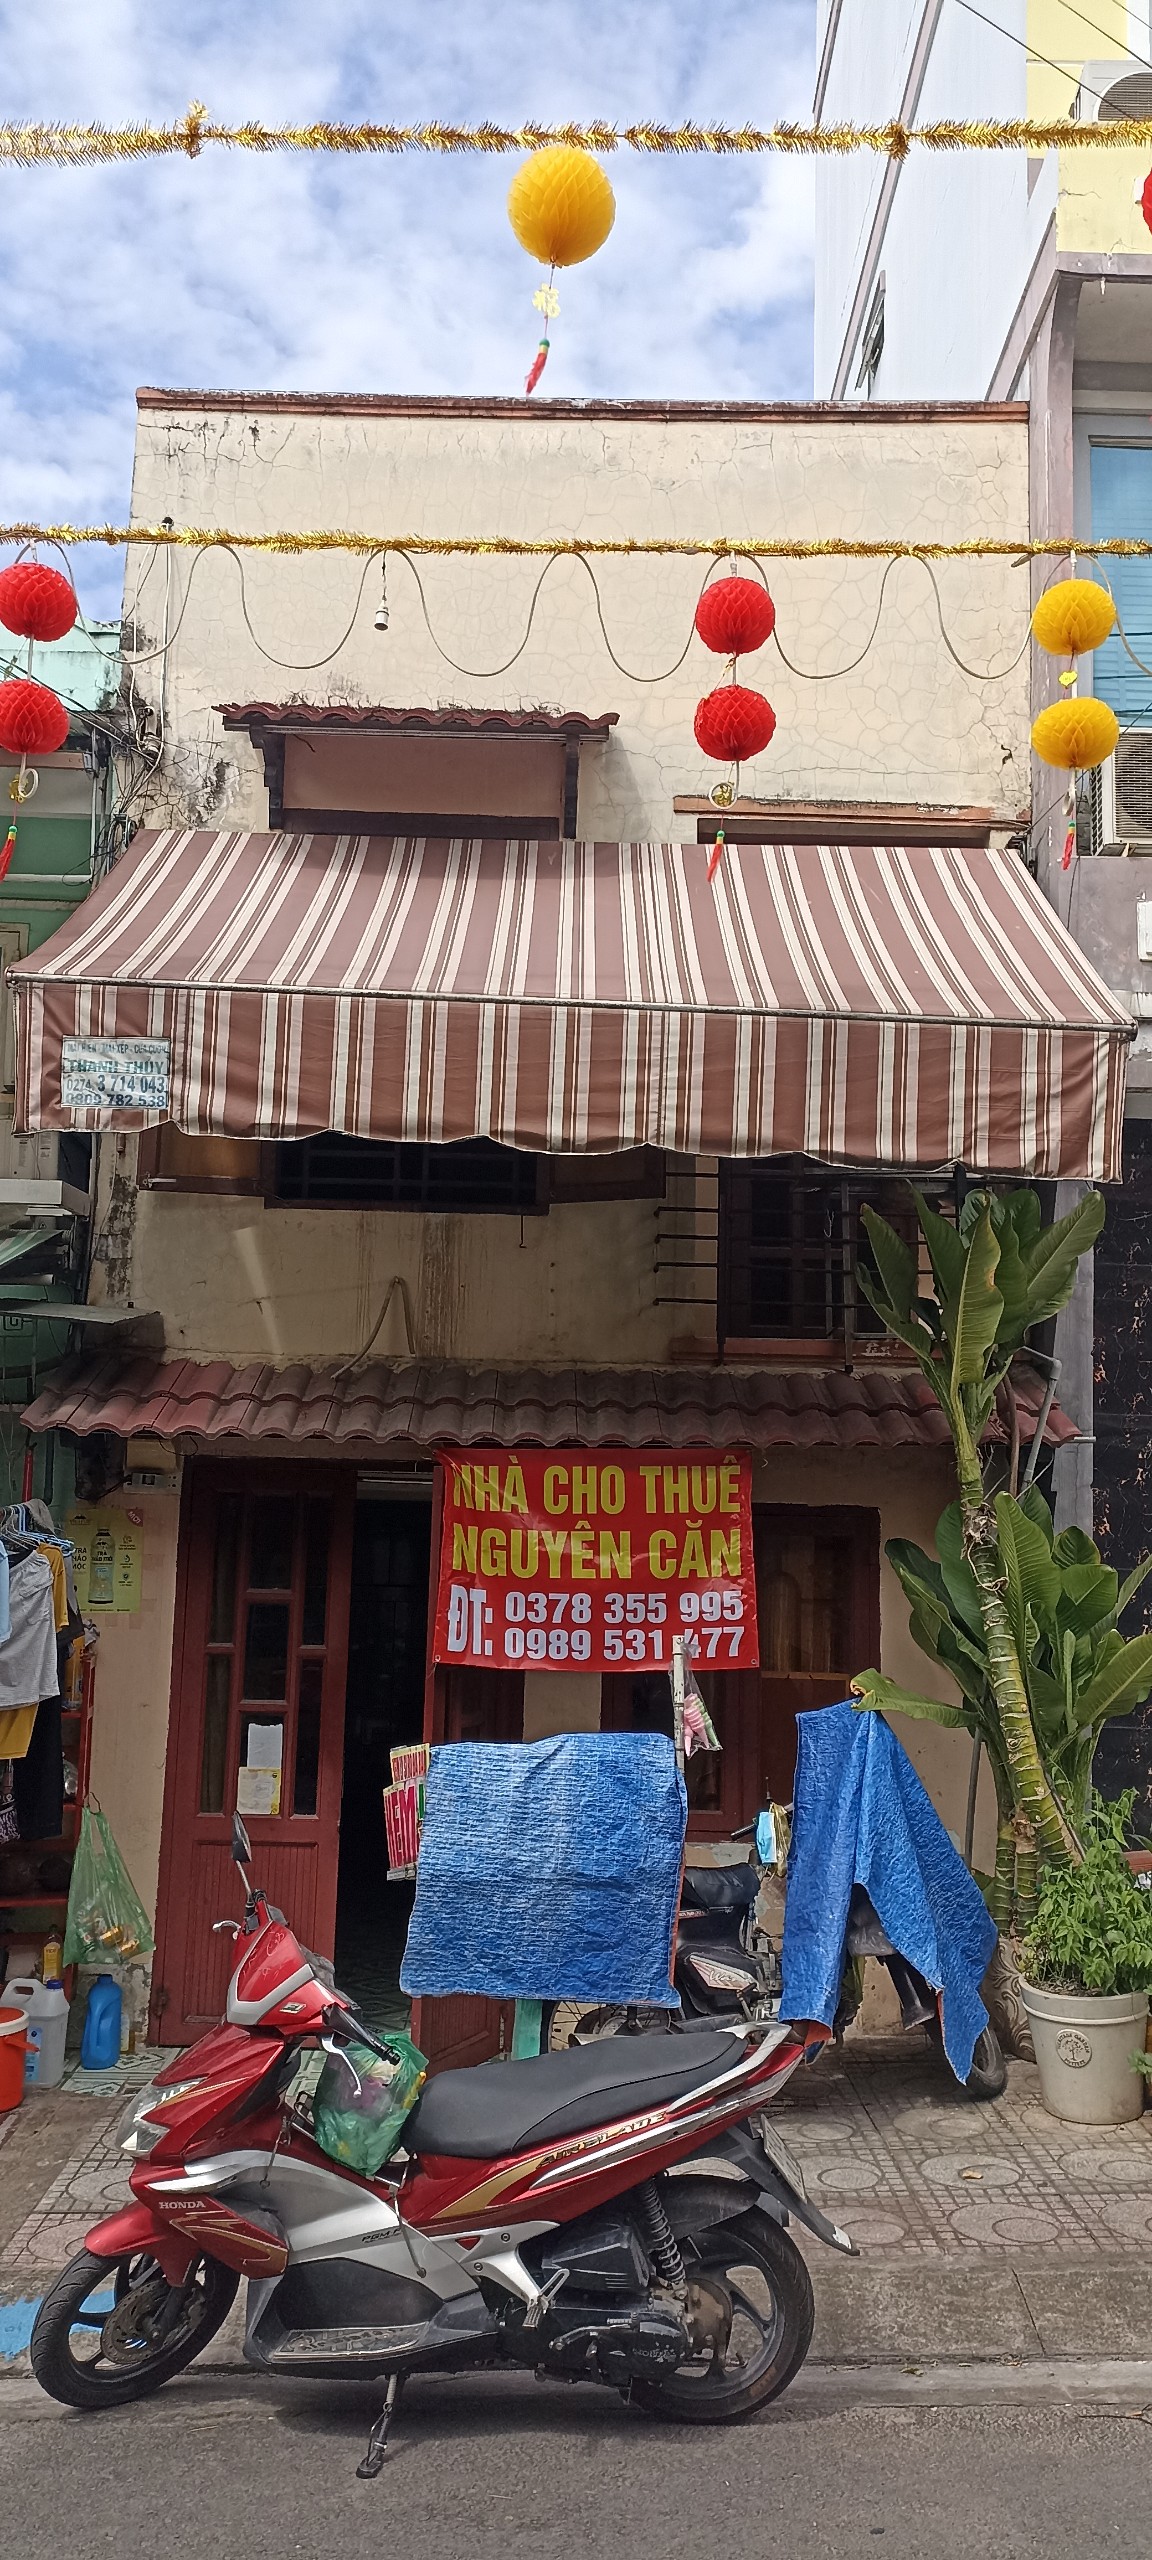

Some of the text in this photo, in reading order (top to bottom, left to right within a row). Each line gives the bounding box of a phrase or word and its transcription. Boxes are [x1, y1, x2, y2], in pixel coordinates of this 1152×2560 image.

[97, 1074, 106, 1092] 3
[110, 1075, 136, 1092] 714
[140, 1076, 165, 1093] 043
[106, 1093, 133, 1106] 782
[453, 1455, 741, 1514] NHÀ CHO THUÊ
[452, 1519, 742, 1580] NGUYÊN CĂN
[447, 1584, 744, 1656] ĐT: 0378 355 995
[504, 1626, 745, 1660] 0989 531 477
[158, 2200, 207, 2210] HONDA
